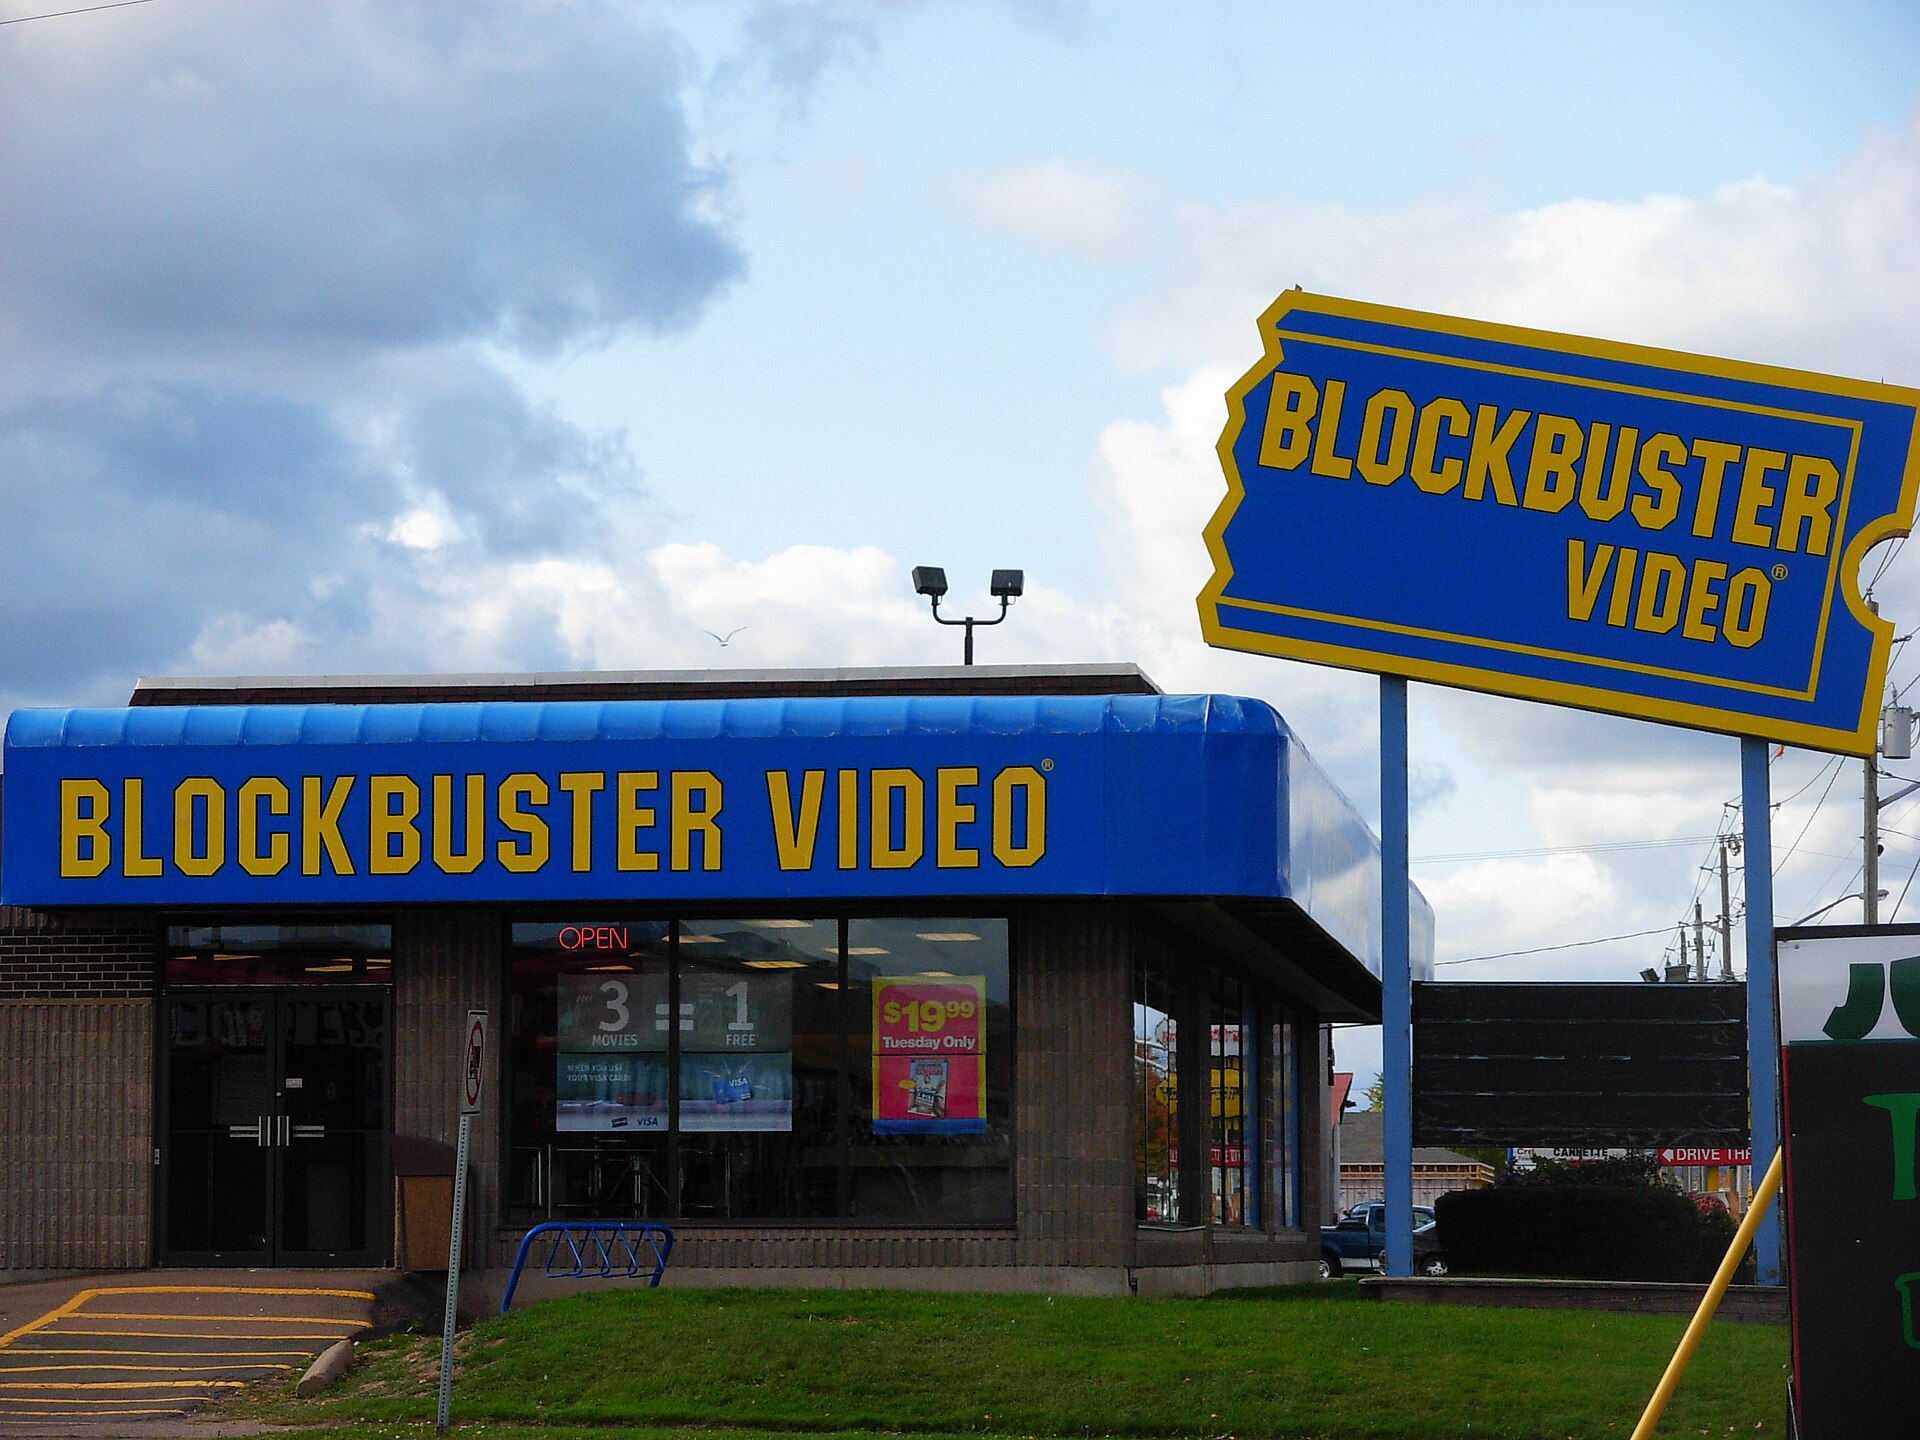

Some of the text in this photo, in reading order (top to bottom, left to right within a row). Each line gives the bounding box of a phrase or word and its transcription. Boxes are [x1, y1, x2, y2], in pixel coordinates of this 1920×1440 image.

[1257, 370, 1843, 557] BLOCKBUSTER
[59, 770, 723, 878] BLOCKBUSTER
[559, 926, 628, 950] OPEN
[599, 980, 630, 1032] 3
[726, 981, 754, 1031] 1
[592, 1034, 638, 1047] MOVIES
[882, 1036, 976, 1051] Tuesday Only
[729, 1078, 748, 1087] VISA
[637, 1117, 658, 1126] VISA
[1676, 1148, 1721, 1161] DRIVE
